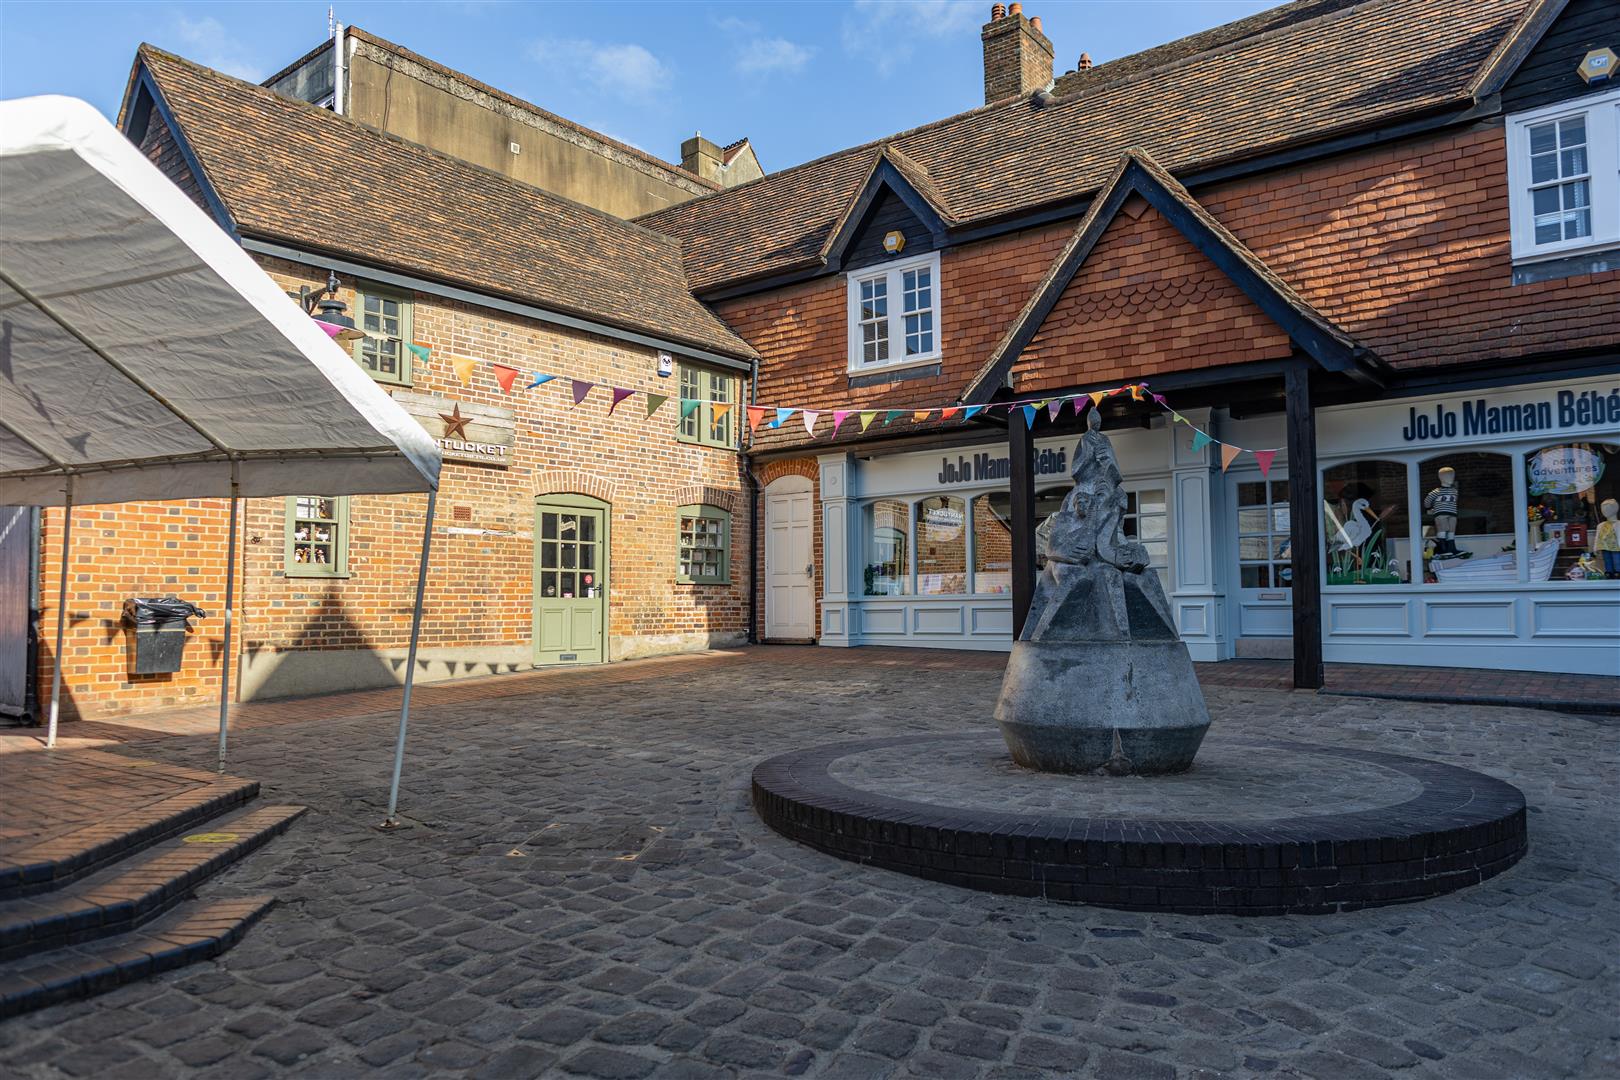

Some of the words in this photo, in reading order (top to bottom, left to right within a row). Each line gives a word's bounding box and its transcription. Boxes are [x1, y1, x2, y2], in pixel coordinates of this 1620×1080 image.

[1403, 404, 1457, 442] JoJo
[1462, 399, 1552, 437] Maman
[1557, 388, 1620, 428] Bébé
[433, 438, 508, 456] NTUCKET
[938, 455, 971, 484] JoJo
[974, 452, 1010, 481] Mam
[1533, 465, 1598, 476] adventures
